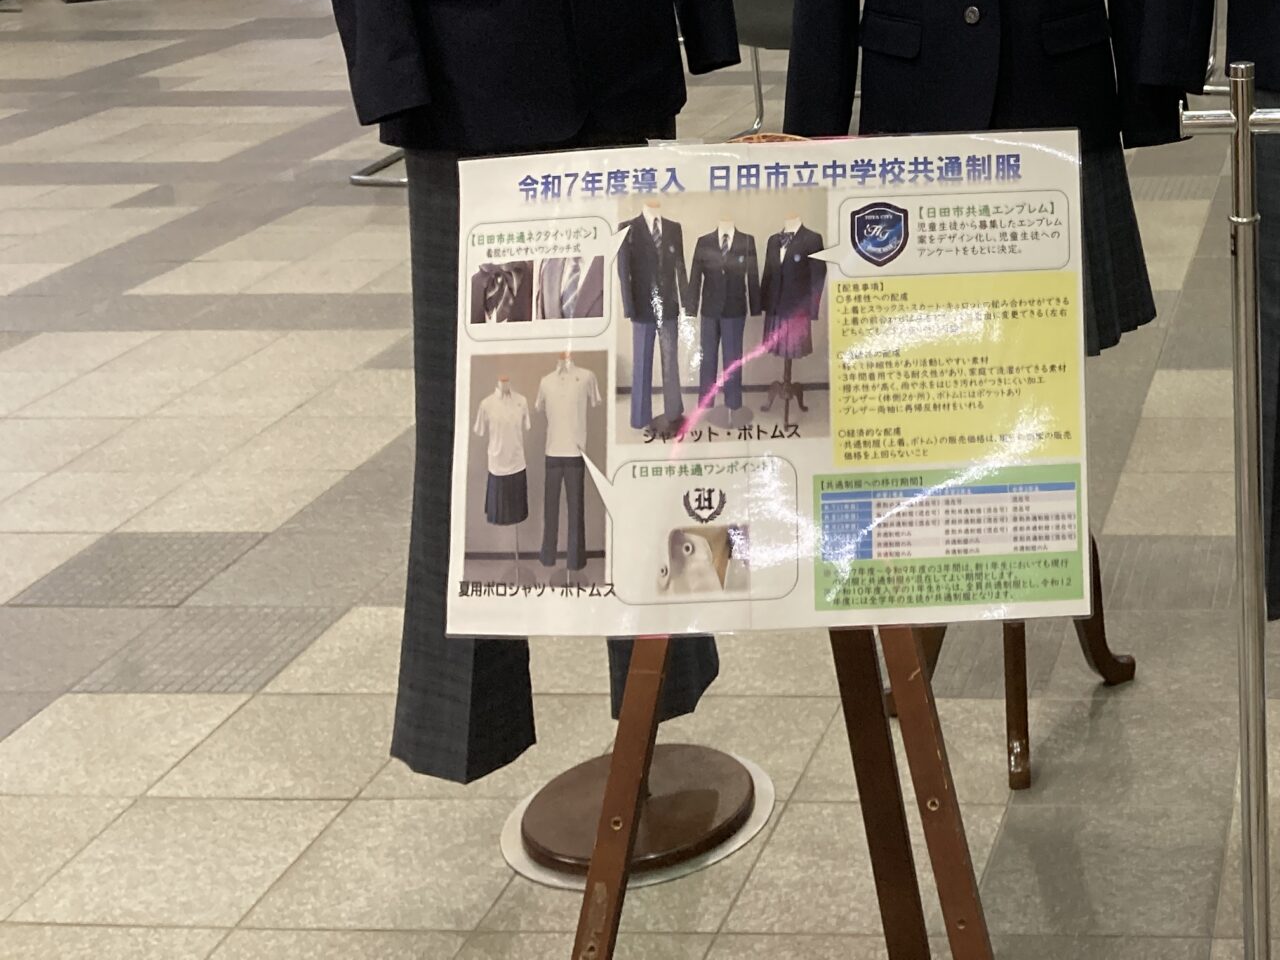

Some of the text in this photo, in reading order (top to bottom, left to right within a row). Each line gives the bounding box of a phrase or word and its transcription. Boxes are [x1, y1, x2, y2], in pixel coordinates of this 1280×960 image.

[518, 153, 1022, 202] 令和7年度導入 日田市立中学校共通制服
[917, 218, 1063, 233] 児童生徒から募集したエンブレム
[917, 244, 1022, 257] アンケートをもとに決定。
[458, 580, 617, 597] 夏用ポロシャツ・ボトムス
